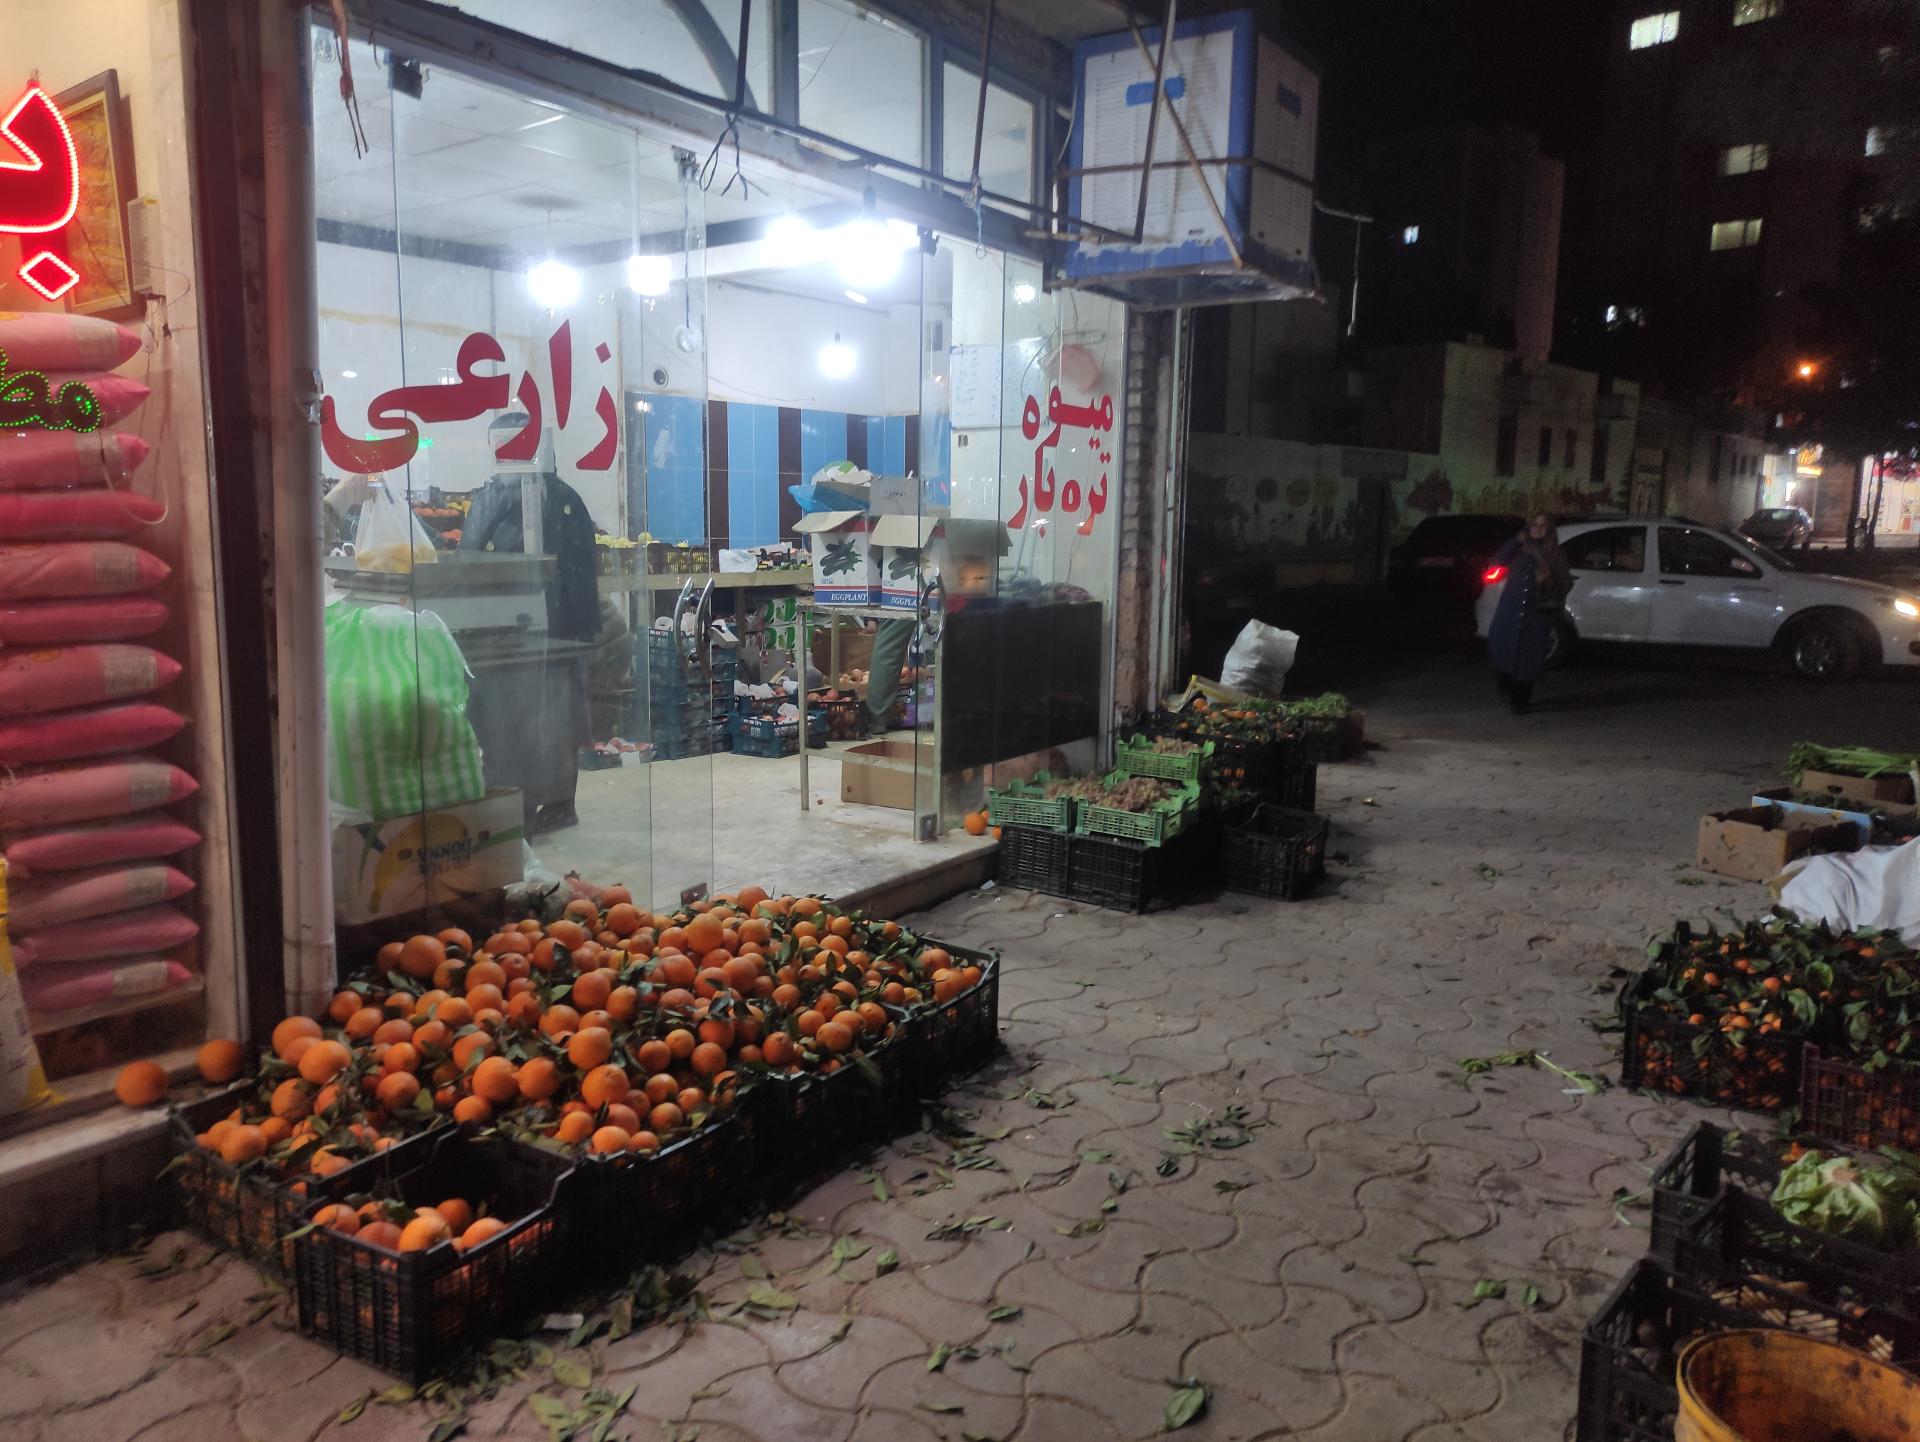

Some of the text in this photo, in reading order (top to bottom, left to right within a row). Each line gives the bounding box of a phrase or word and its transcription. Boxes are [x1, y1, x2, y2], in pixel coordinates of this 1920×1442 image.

[320, 317, 619, 475] زارعی
[1022, 385, 1114, 449] میوه
[831, 593, 868, 602] EGGPLANT
